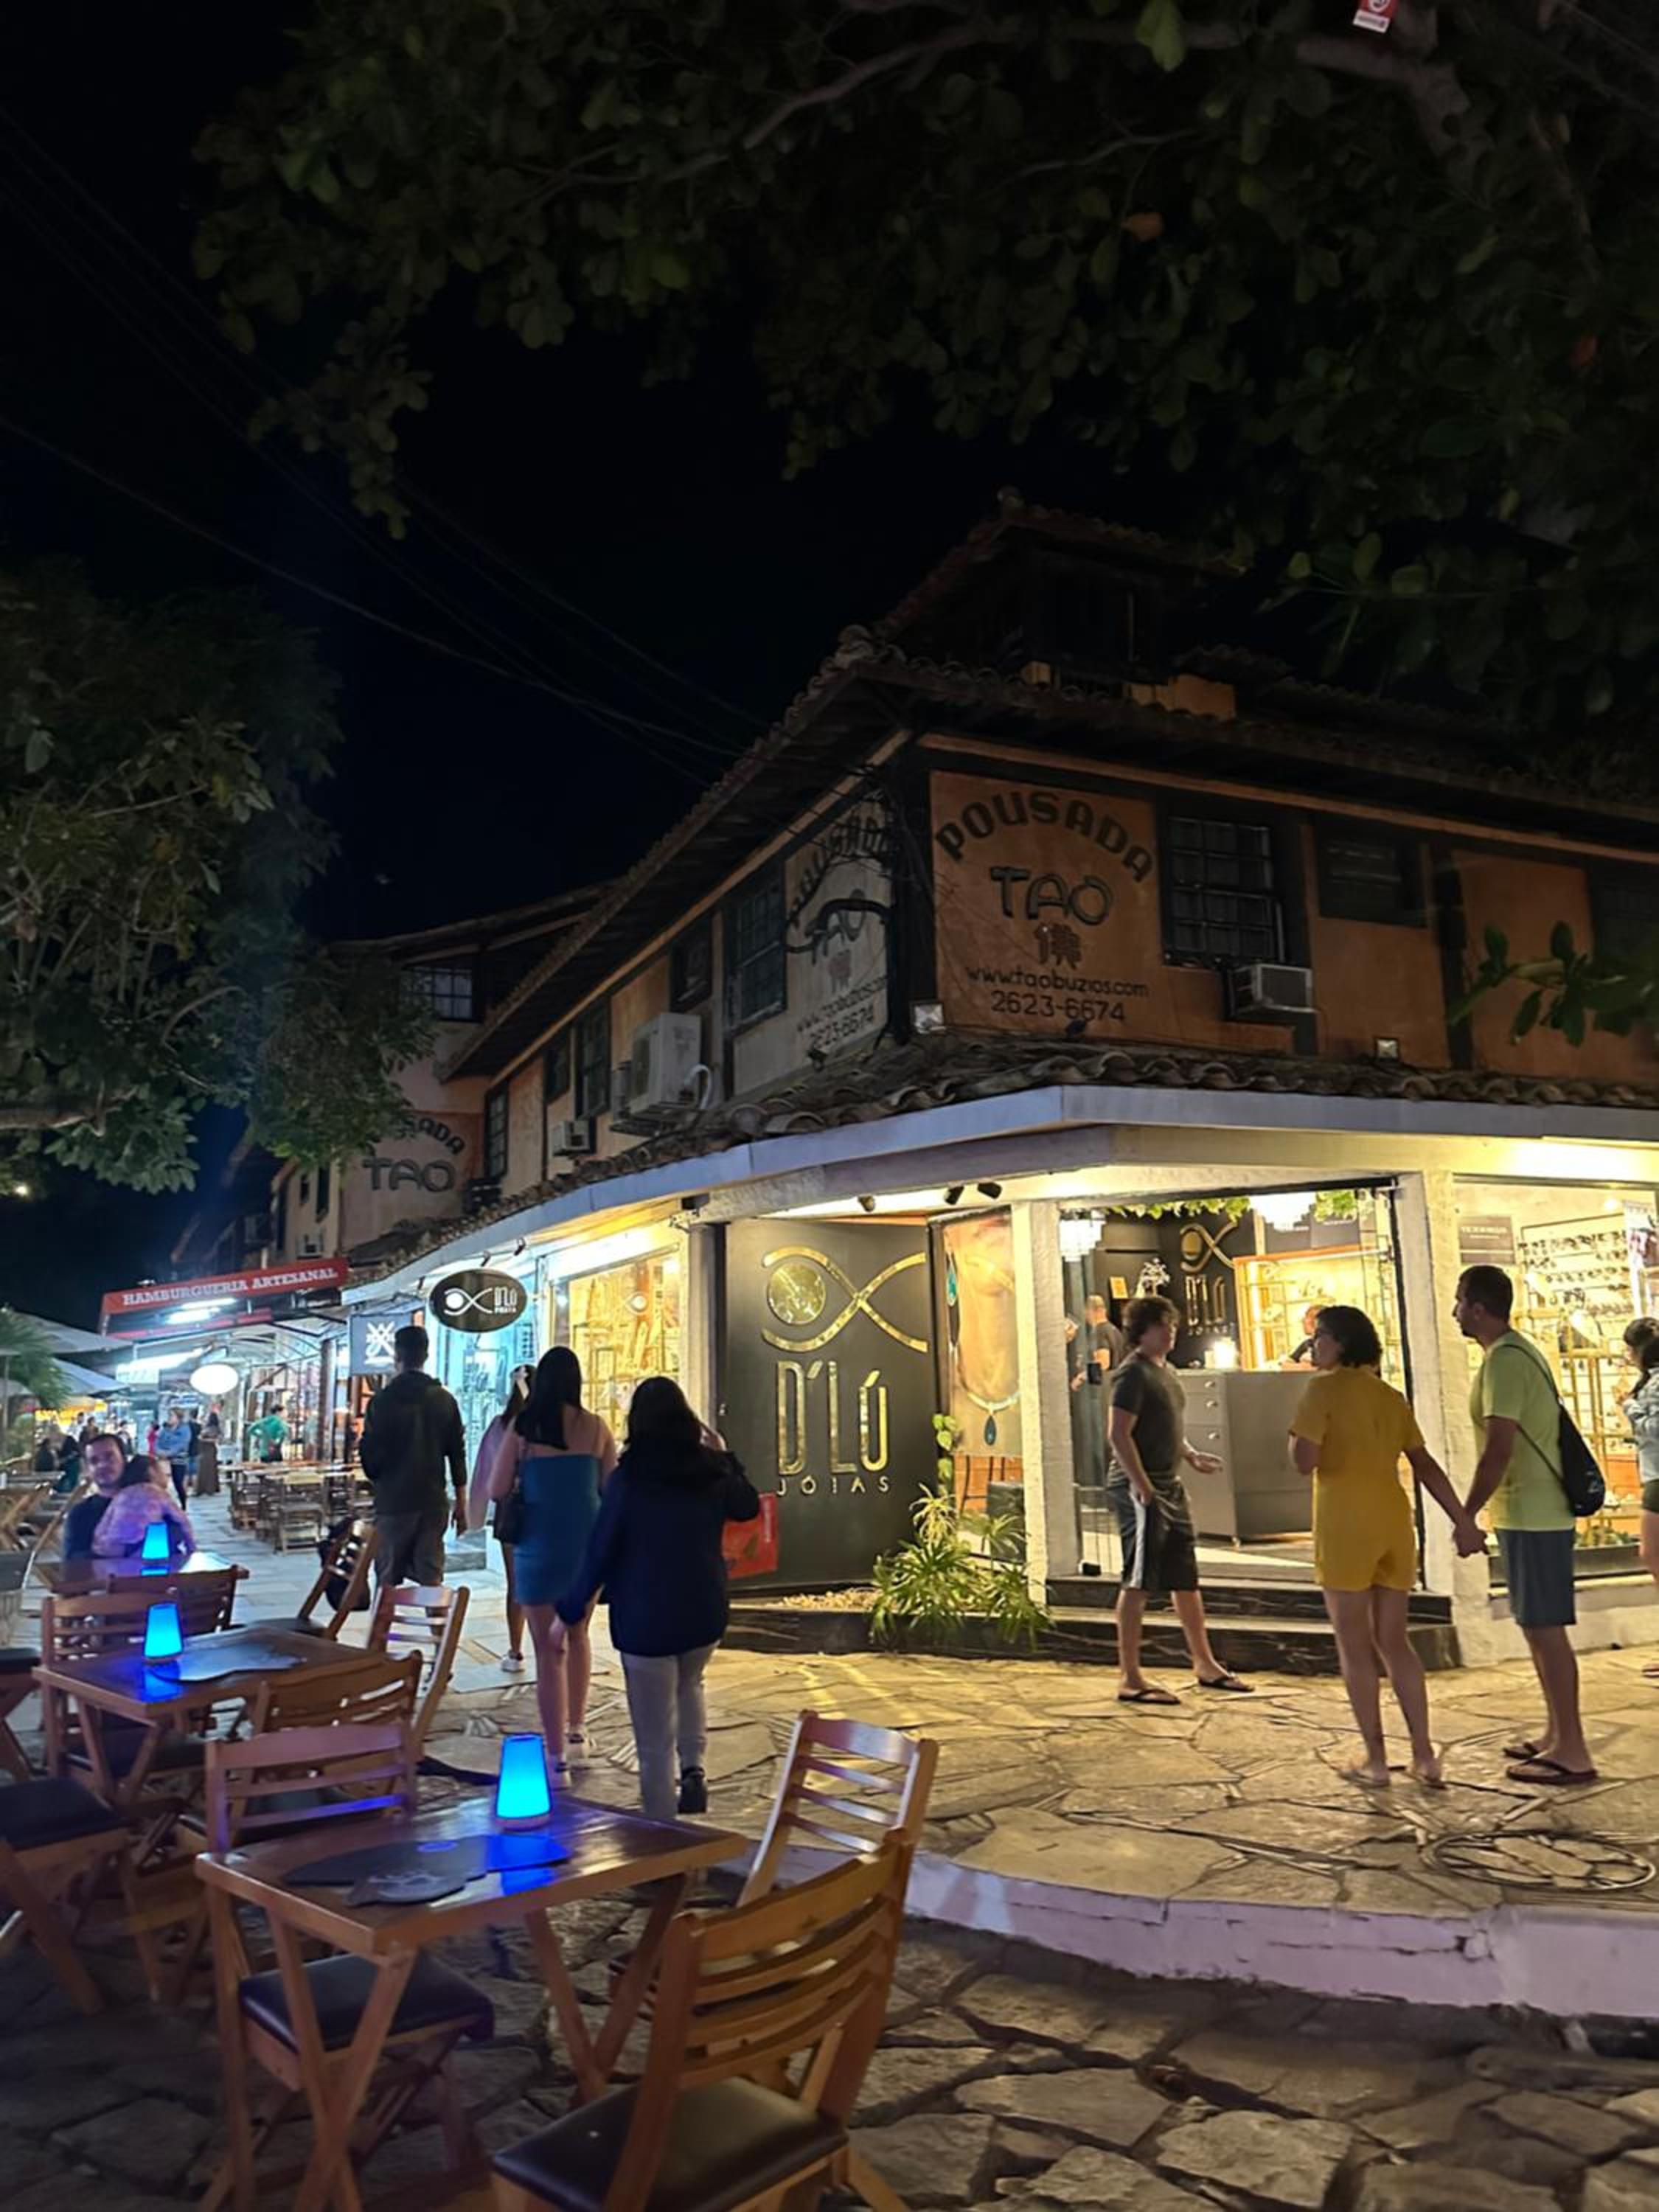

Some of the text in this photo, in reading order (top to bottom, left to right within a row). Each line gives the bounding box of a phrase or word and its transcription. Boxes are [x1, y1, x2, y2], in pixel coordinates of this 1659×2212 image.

[933, 791, 1153, 883] POUSADA
[990, 866, 1112, 925] TAO
[991, 990, 1126, 1022] 2623-6674
[362, 1157, 456, 1192] TAO
[122, 1267, 338, 1306] HAMBURGUERIA ARTESANAL
[776, 1475, 891, 1497] JOIAS
